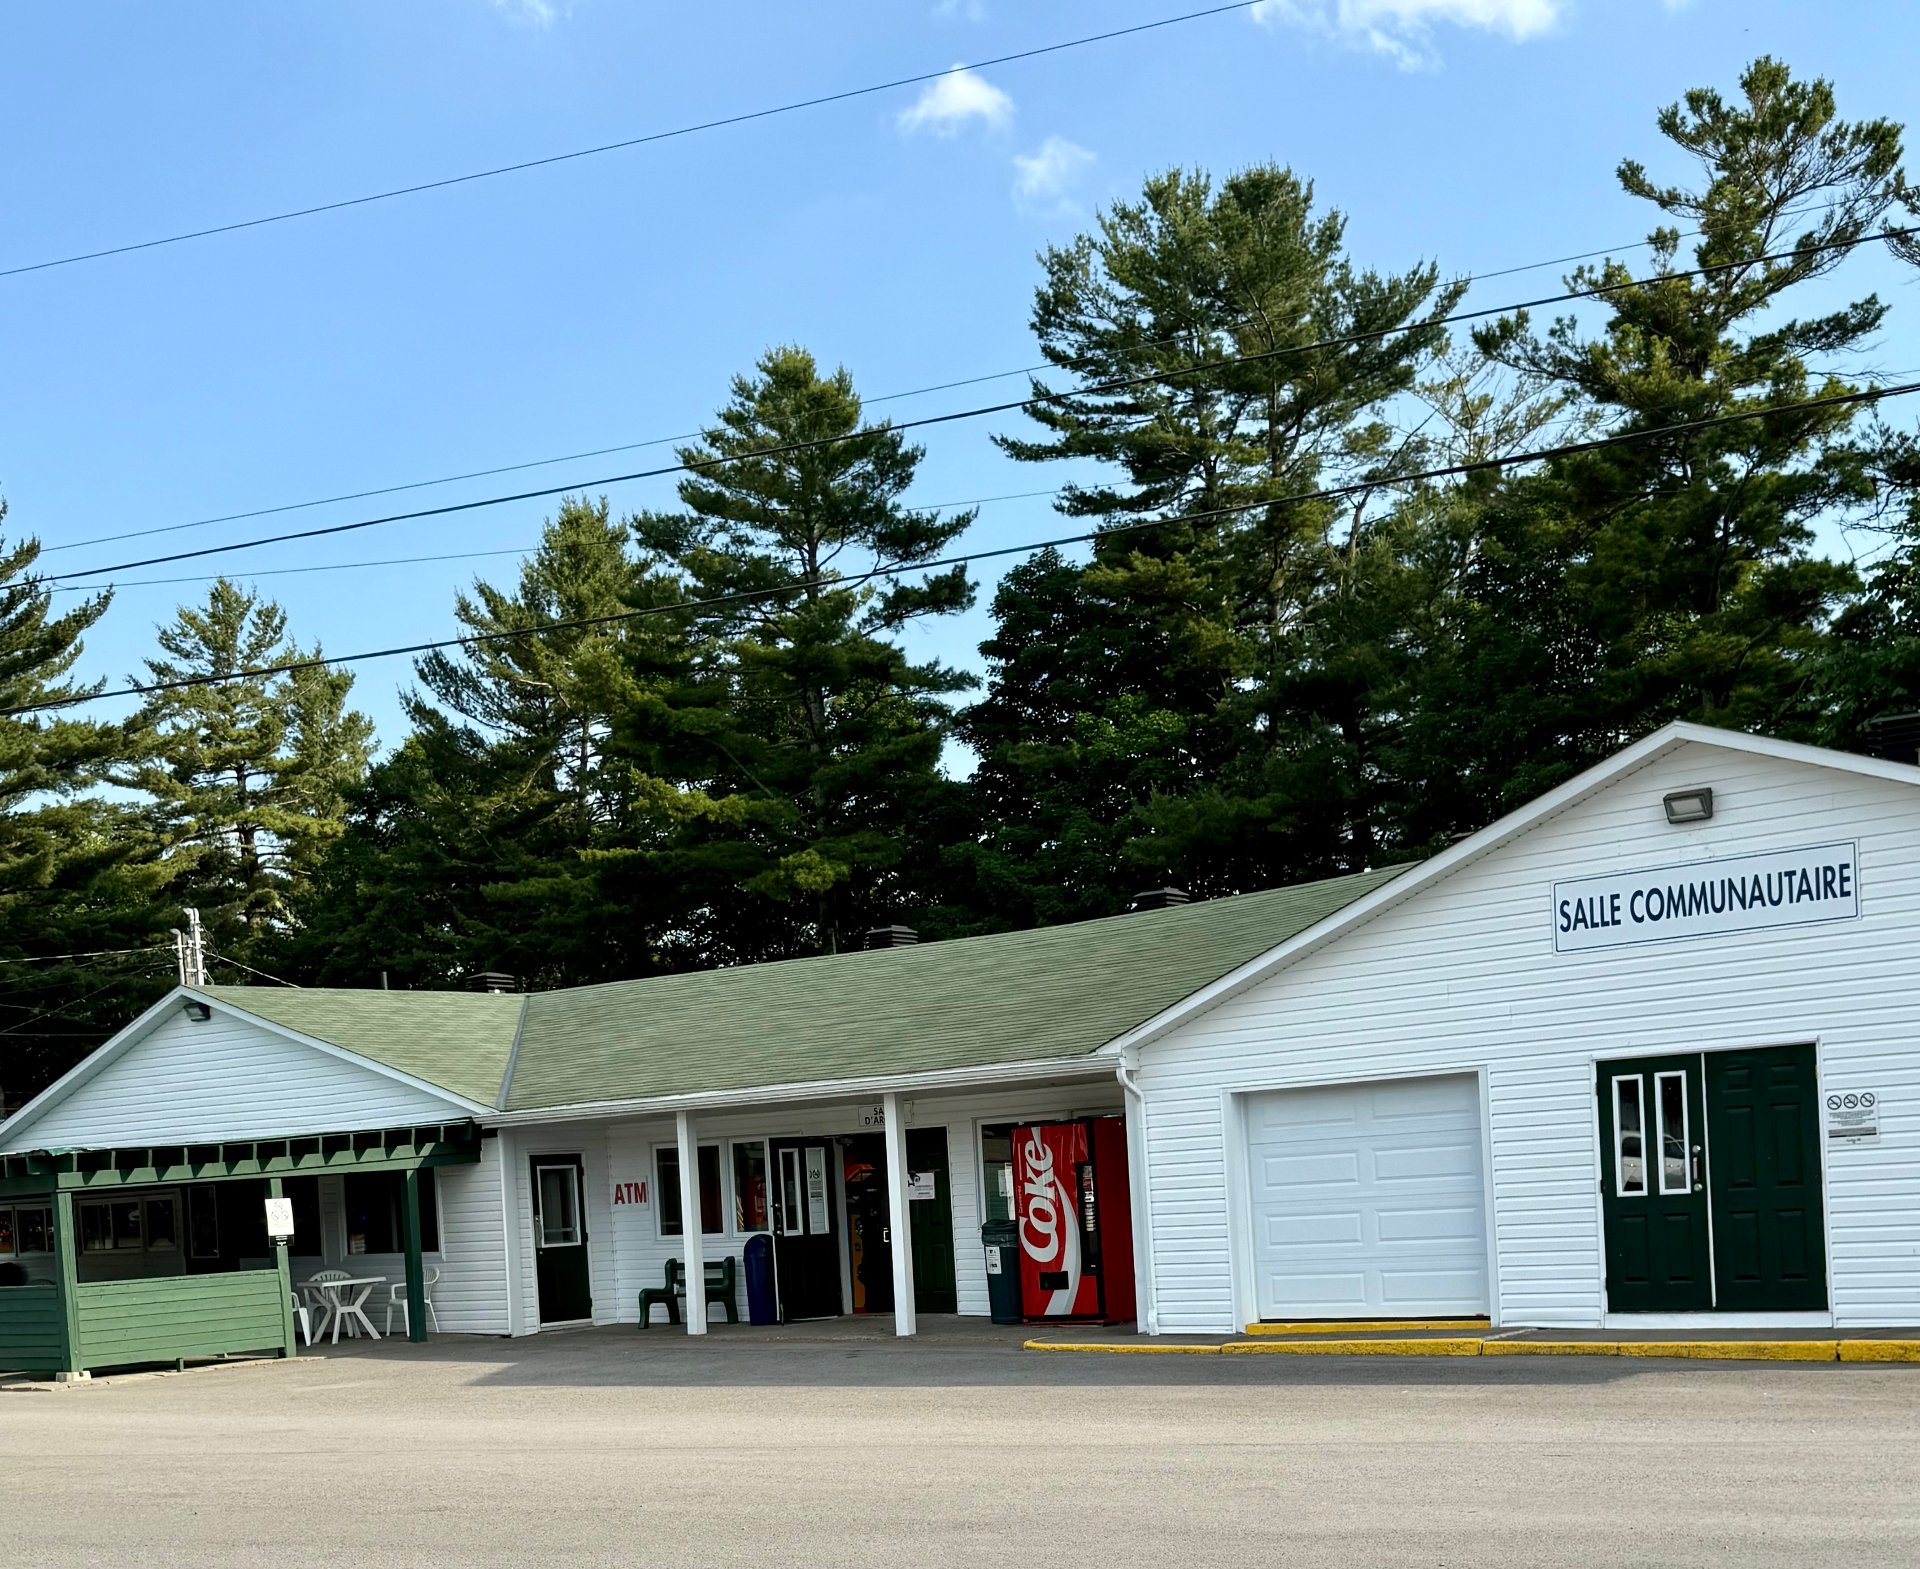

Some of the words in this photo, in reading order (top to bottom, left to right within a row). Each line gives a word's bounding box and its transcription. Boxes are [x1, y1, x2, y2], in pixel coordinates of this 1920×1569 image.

[1559, 893, 1621, 933] SALLE
[1629, 863, 1851, 923] COMMUNAUTAIRE
[864, 1115, 886, 1125] D'AR
[614, 1181, 647, 1205] ATM
[1019, 1140, 1059, 1262] Coke
